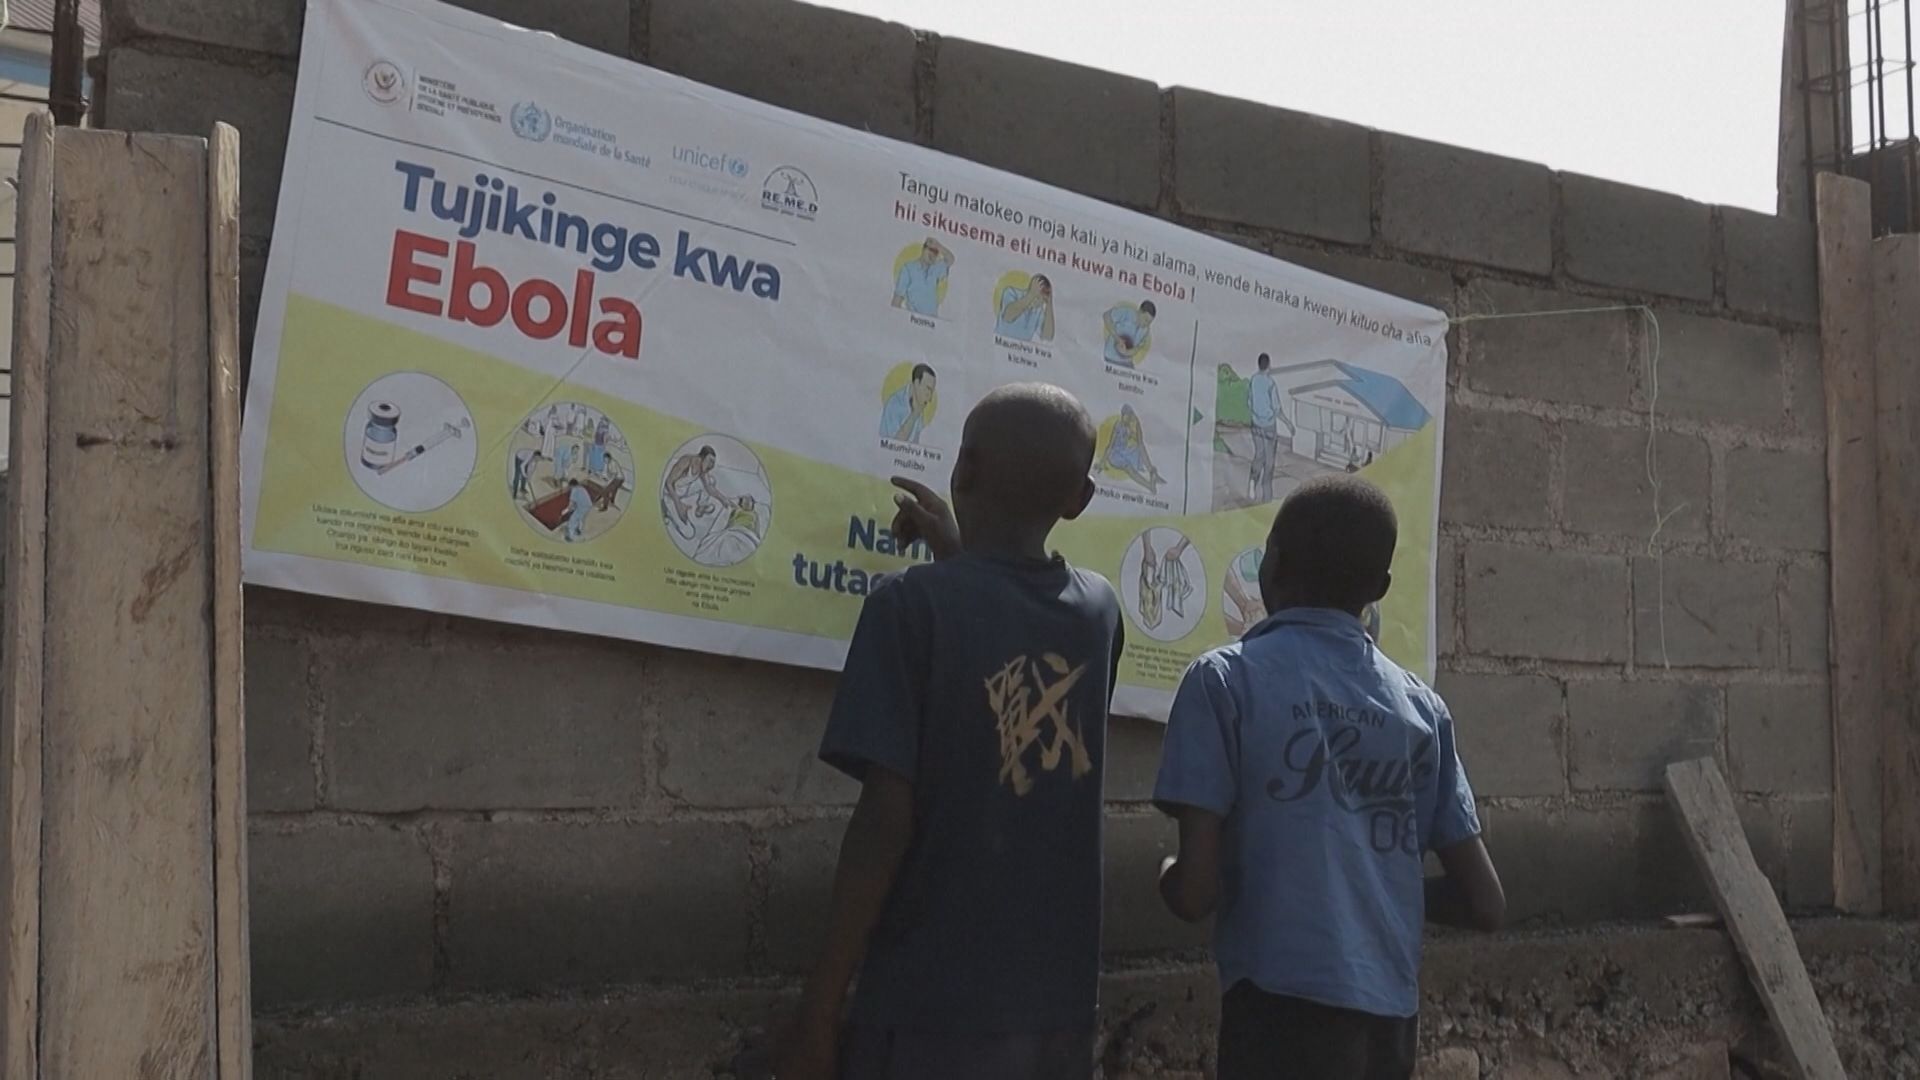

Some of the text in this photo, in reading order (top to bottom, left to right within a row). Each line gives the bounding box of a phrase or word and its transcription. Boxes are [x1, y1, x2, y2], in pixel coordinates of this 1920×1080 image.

[555, 116, 616, 143] Organisation
[553, 135, 651, 168] mondiale de la Santé
[672, 145, 727, 172] unicef
[395, 160, 781, 301] Tujikinge kwa
[895, 200, 916, 223] hii
[922, 211, 1005, 249] sikusema
[1011, 234, 1031, 255] eti
[1036, 246, 1067, 266] una
[1072, 252, 1114, 280] kuwa
[1118, 269, 1138, 286] na
[1143, 272, 1186, 301] Ebola
[899, 171, 948, 204] Tangu
[954, 191, 1023, 224] matokeo
[1028, 215, 1065, 239] moja
[1071, 224, 1096, 246] kali
[1101, 235, 1118, 255] ya
[1124, 237, 1149, 261] hizi
[1153, 248, 1199, 281] alama,
[1204, 268, 1250, 293] wende
[1255, 280, 1299, 308] haraka
[1303, 296, 1347, 326] kwenyi
[1350, 310, 1379, 333] kituo
[1381, 320, 1403, 342] cha
[386, 229, 642, 359] Ebola
[910, 315, 936, 329] homa
[994, 335, 1052, 359] Maumivu kwa
[1007, 353, 1038, 368] kichwa
[1105, 364, 1158, 386] Maumivu kwa
[880, 439, 942, 461] Maumivu kwa
